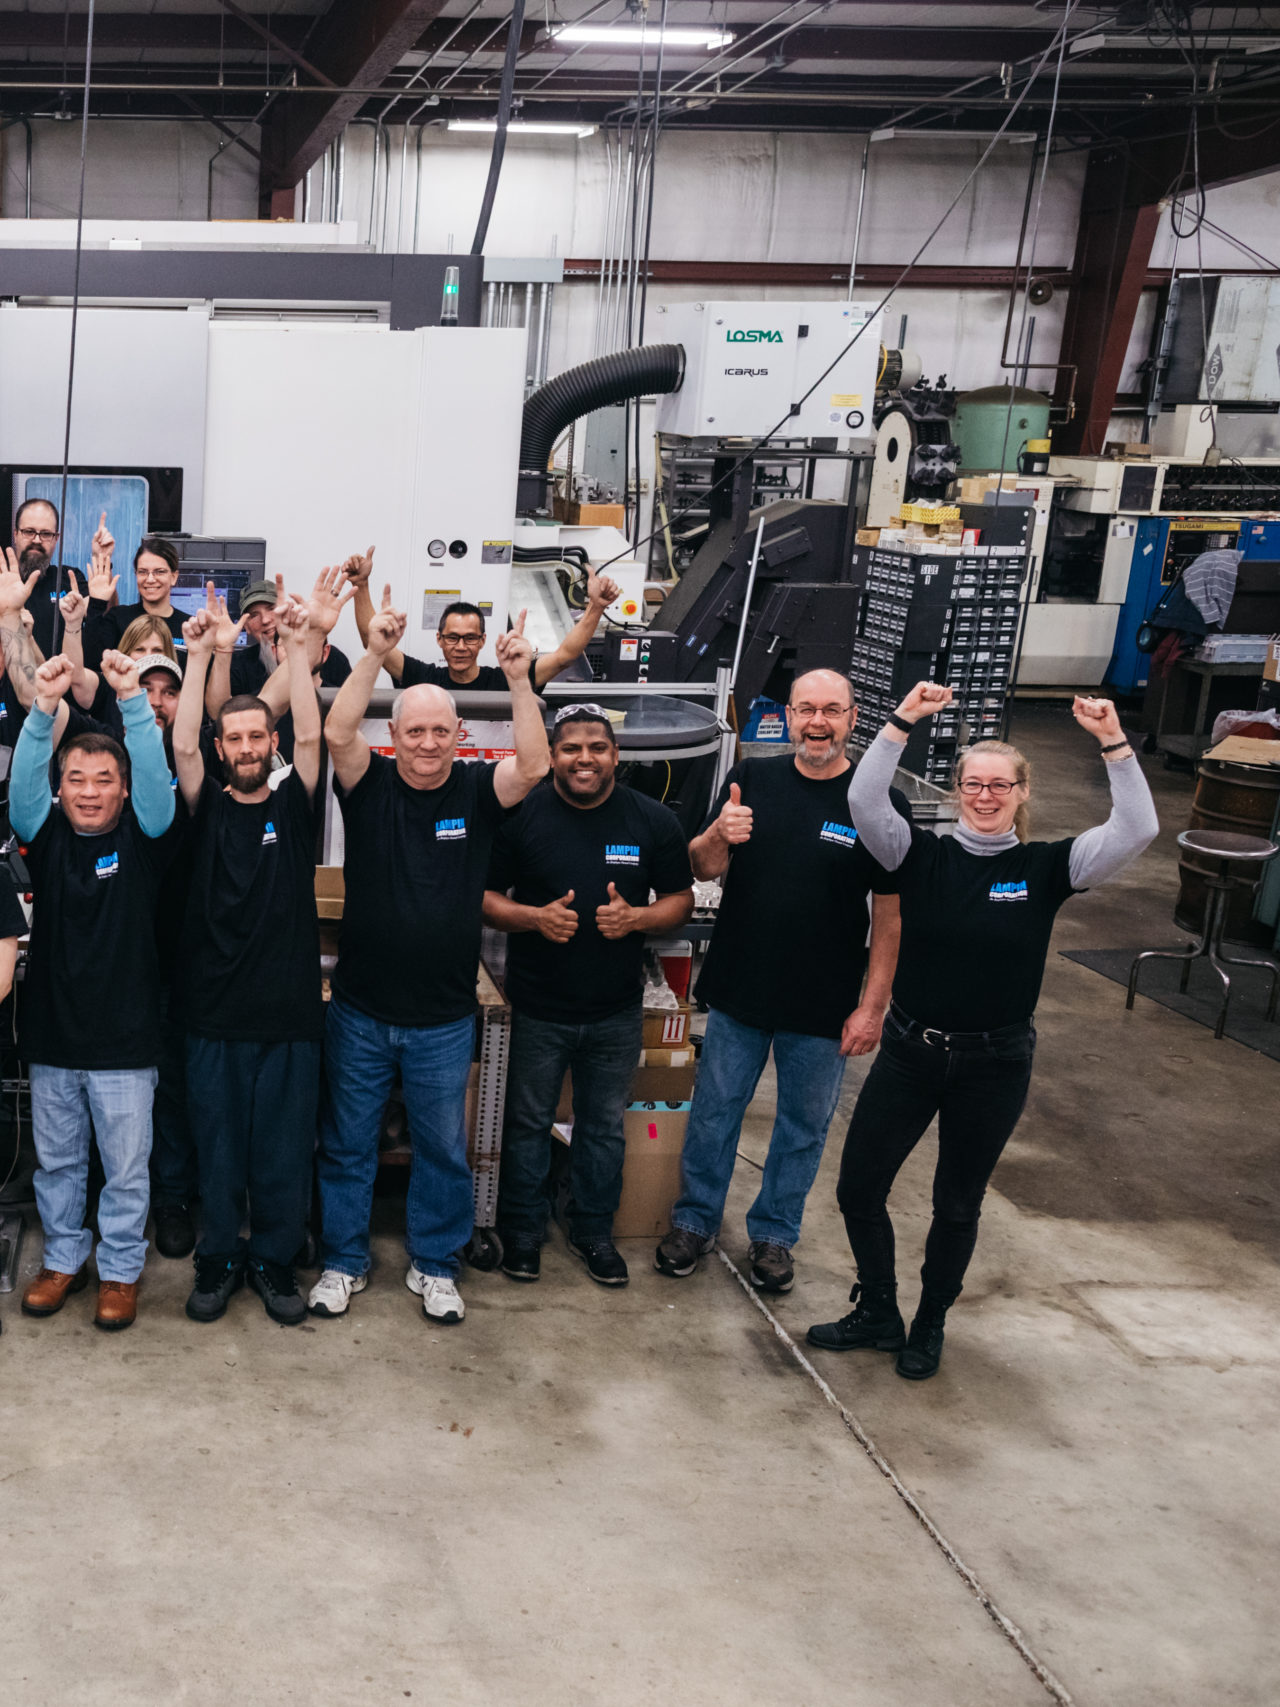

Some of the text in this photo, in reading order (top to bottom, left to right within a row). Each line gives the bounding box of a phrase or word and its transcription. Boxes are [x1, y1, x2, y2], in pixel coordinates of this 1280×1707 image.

[726, 330, 783, 343] LOSMA
[436, 818, 465, 832] LAMPIN
[822, 821, 859, 840] LAMPIN
[606, 845, 640, 857] LAMPIN
[990, 880, 1028, 894] LAMPIN
